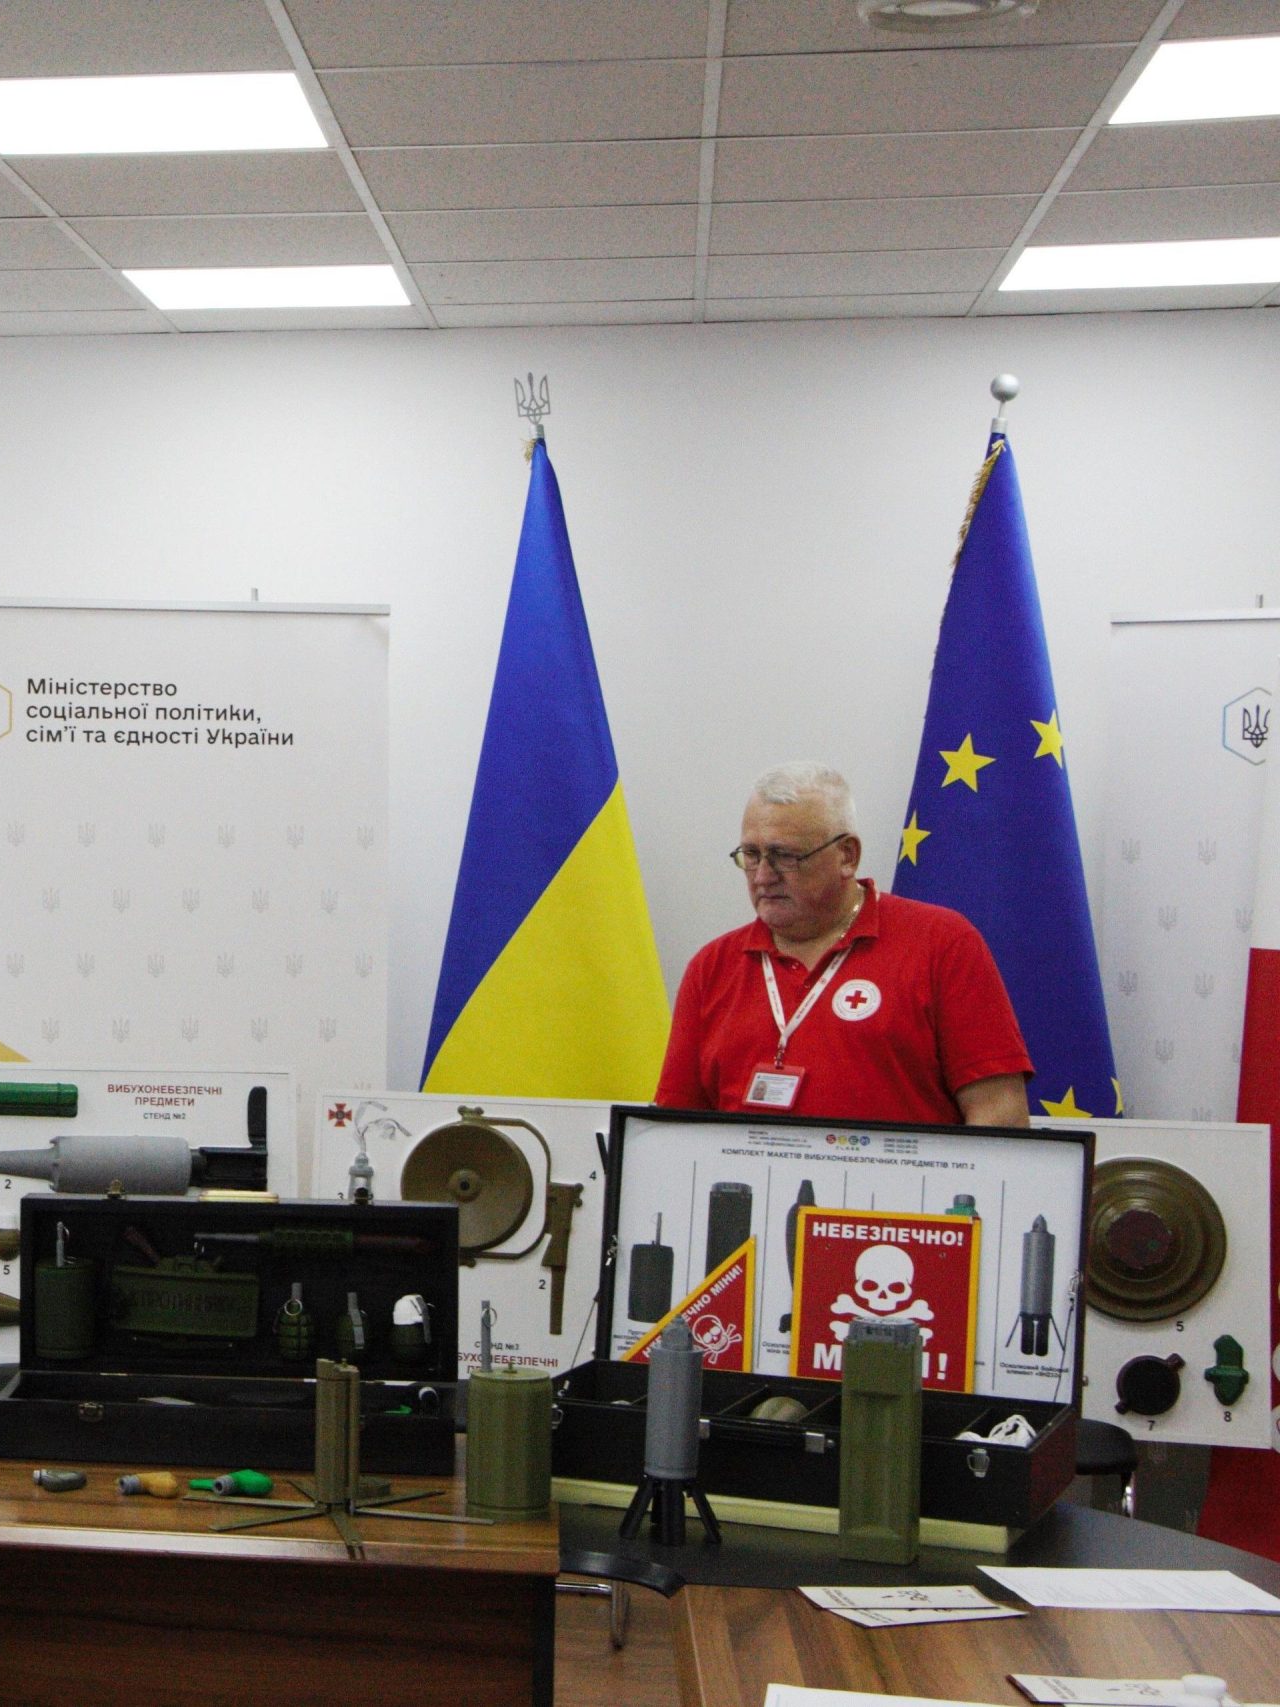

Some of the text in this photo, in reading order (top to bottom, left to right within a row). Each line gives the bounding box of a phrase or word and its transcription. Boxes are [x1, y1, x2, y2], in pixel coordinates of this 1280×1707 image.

[27, 678, 177, 698] Міністерство
[26, 702, 261, 724] соціальної політики,
[83, 729, 106, 743] та
[114, 728, 198, 747] єдності
[206, 728, 294, 748] України
[107, 1084, 222, 1095] ВИБУХОНЕБЕЗПЕЧНІ
[135, 1097, 195, 1107] ПРЕДМЕТИ
[143, 1112, 171, 1120] СТЕНД
[721, 1148, 765, 1157] КОМПЛЕКТ
[589, 1170, 597, 1181] 4
[5, 1179, 12, 1189] 2
[812, 1221, 964, 1247] НЕБЕЗПЕЧНО!
[3, 1265, 10, 1275] 5
[538, 1279, 546, 1289] 2
[1176, 1321, 1184, 1332] 5
[458, 1352, 558, 1368] БУХОЕБЕЗПЕЧНІ
[1223, 1411, 1232, 1422] 8
[1147, 1420, 1155, 1431] 7
